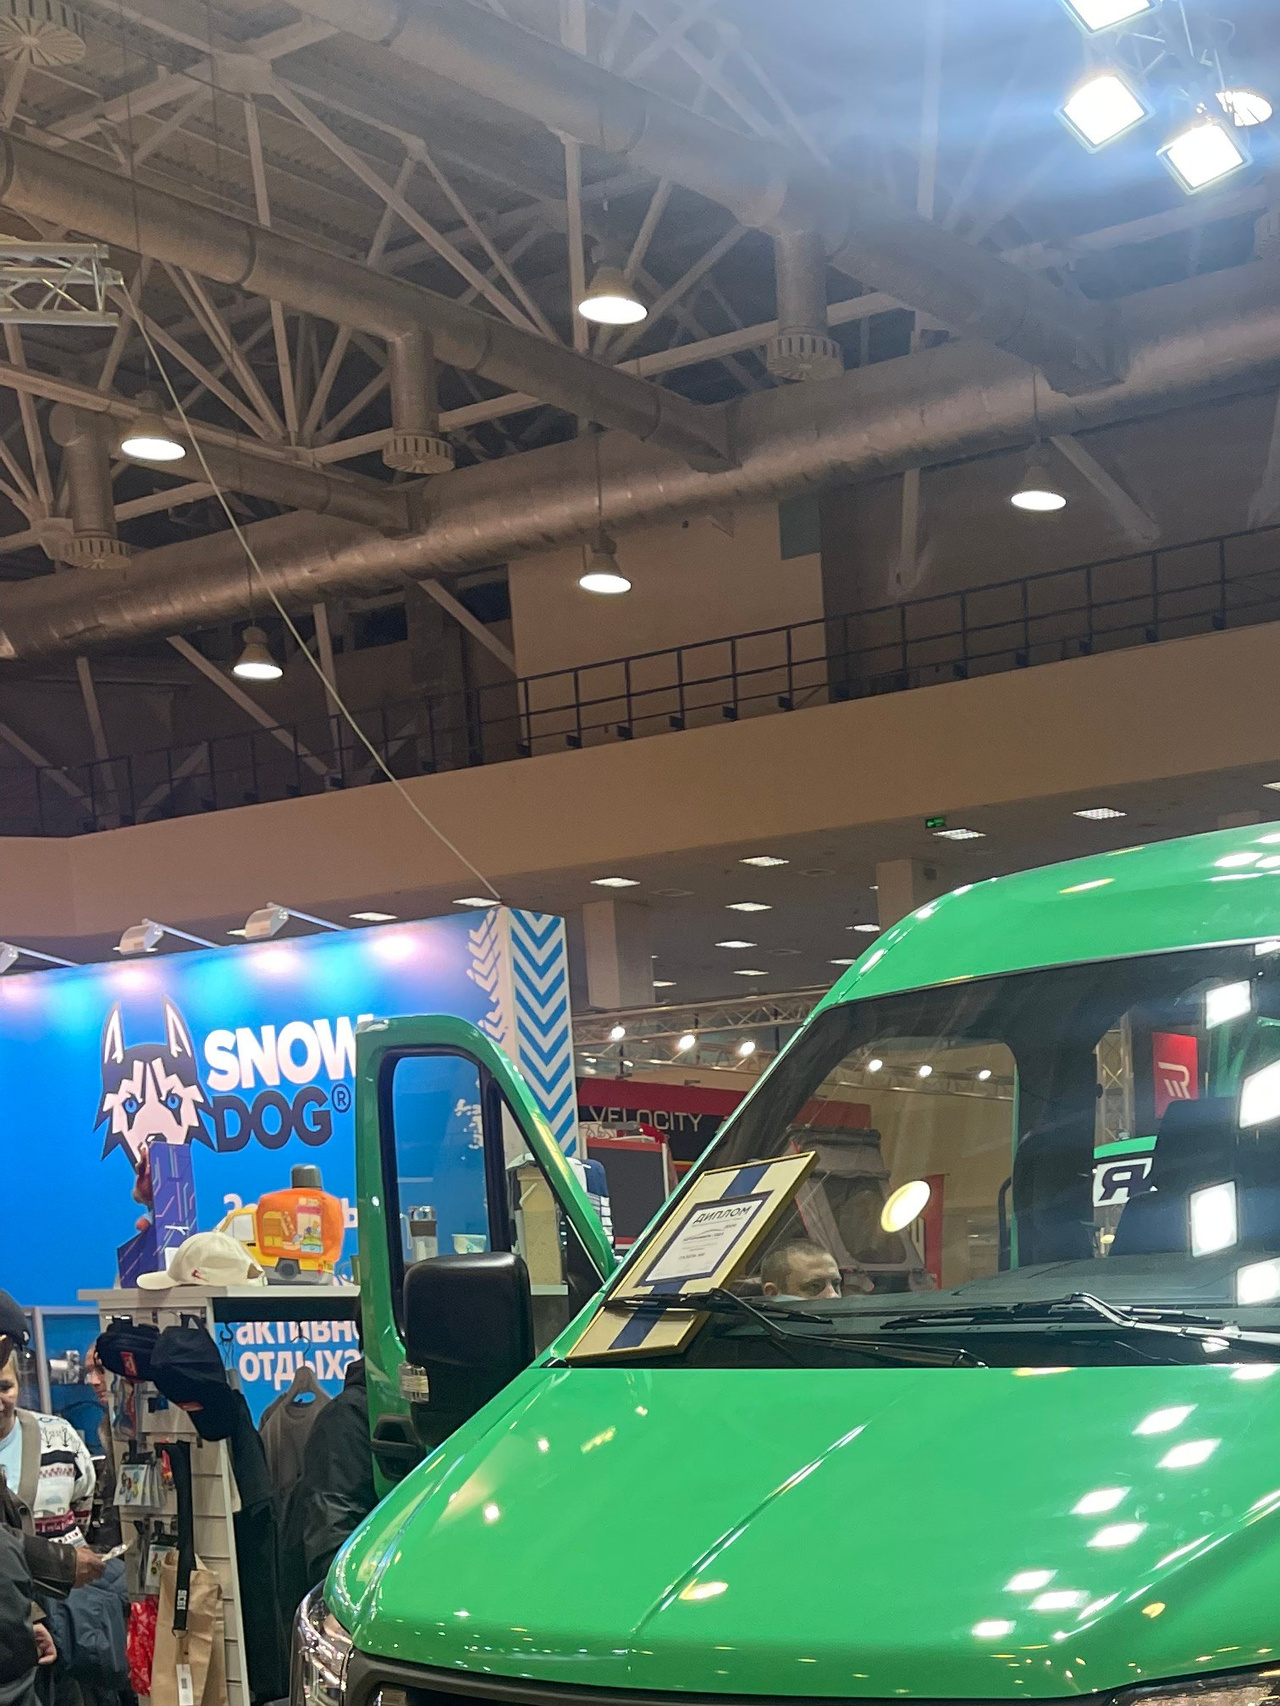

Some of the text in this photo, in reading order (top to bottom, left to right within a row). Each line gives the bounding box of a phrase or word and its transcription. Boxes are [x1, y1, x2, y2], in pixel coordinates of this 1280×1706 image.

[204, 1013, 373, 1091] SNOW
[589, 1106, 703, 1132] VELOCITY
[693, 1205, 752, 1225] ДИПЛОМ
[236, 1320, 359, 1345] активн
